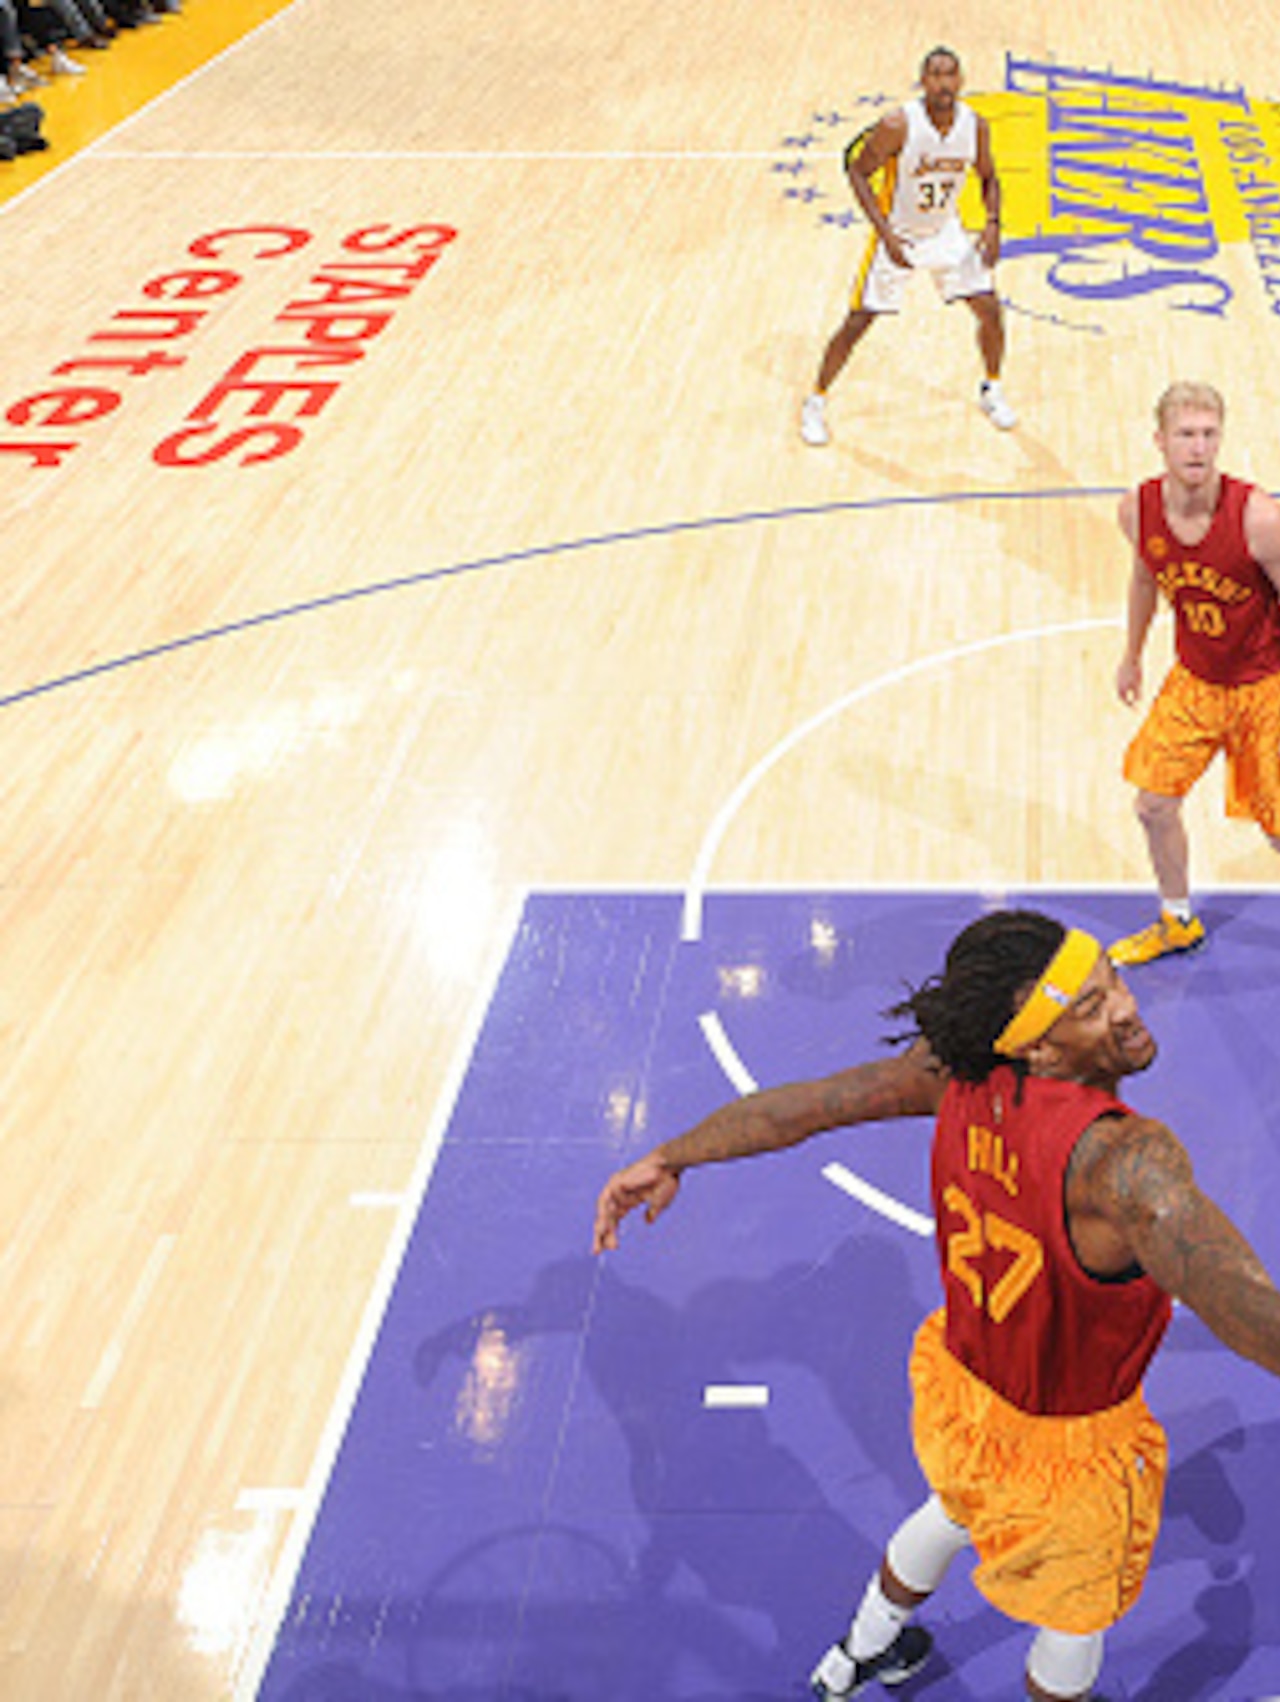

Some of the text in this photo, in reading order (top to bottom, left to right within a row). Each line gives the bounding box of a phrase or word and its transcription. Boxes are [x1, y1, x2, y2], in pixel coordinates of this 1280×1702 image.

[917, 180, 956, 214] 37
[999, 50, 1251, 319] LAKERS
[0, 223, 314, 468] Center
[152, 223, 459, 467] STAPLES
[1181, 600, 1227, 639] 10
[967, 1124, 1019, 1196] HILL
[942, 1183, 1044, 1325] 27
